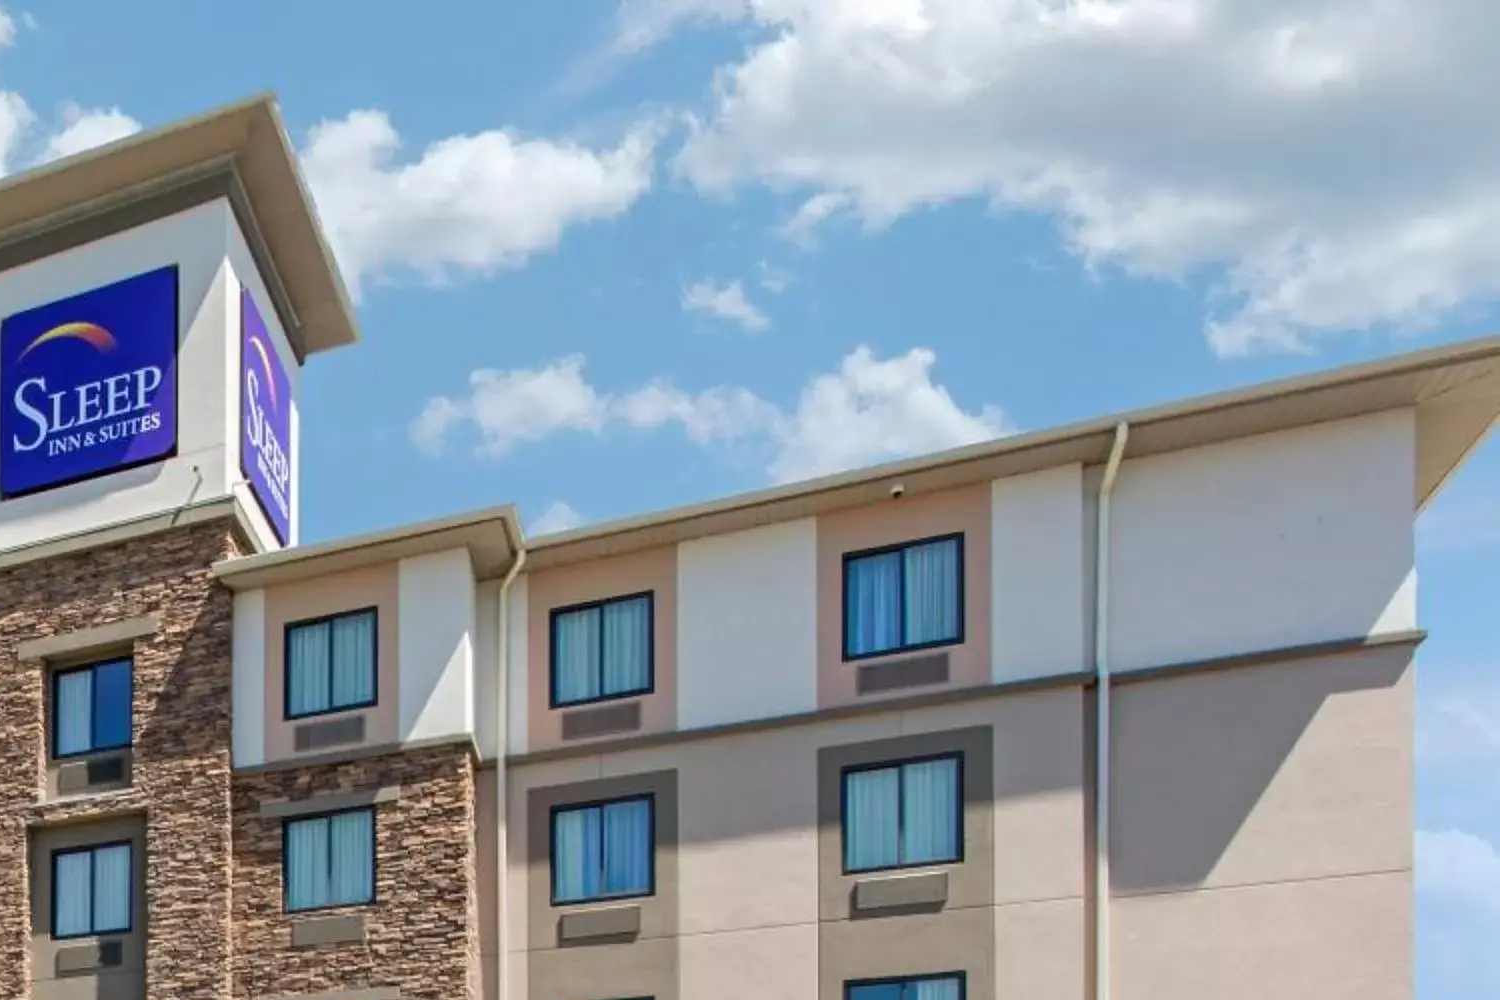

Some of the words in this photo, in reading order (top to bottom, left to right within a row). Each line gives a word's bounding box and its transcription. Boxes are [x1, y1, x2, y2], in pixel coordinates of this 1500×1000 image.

[13, 365, 162, 452] SLEEP
[48, 433, 81, 457] INN
[83, 431, 100, 447] &
[99, 411, 161, 443] SUITES
[247, 367, 289, 493] SLEEP
